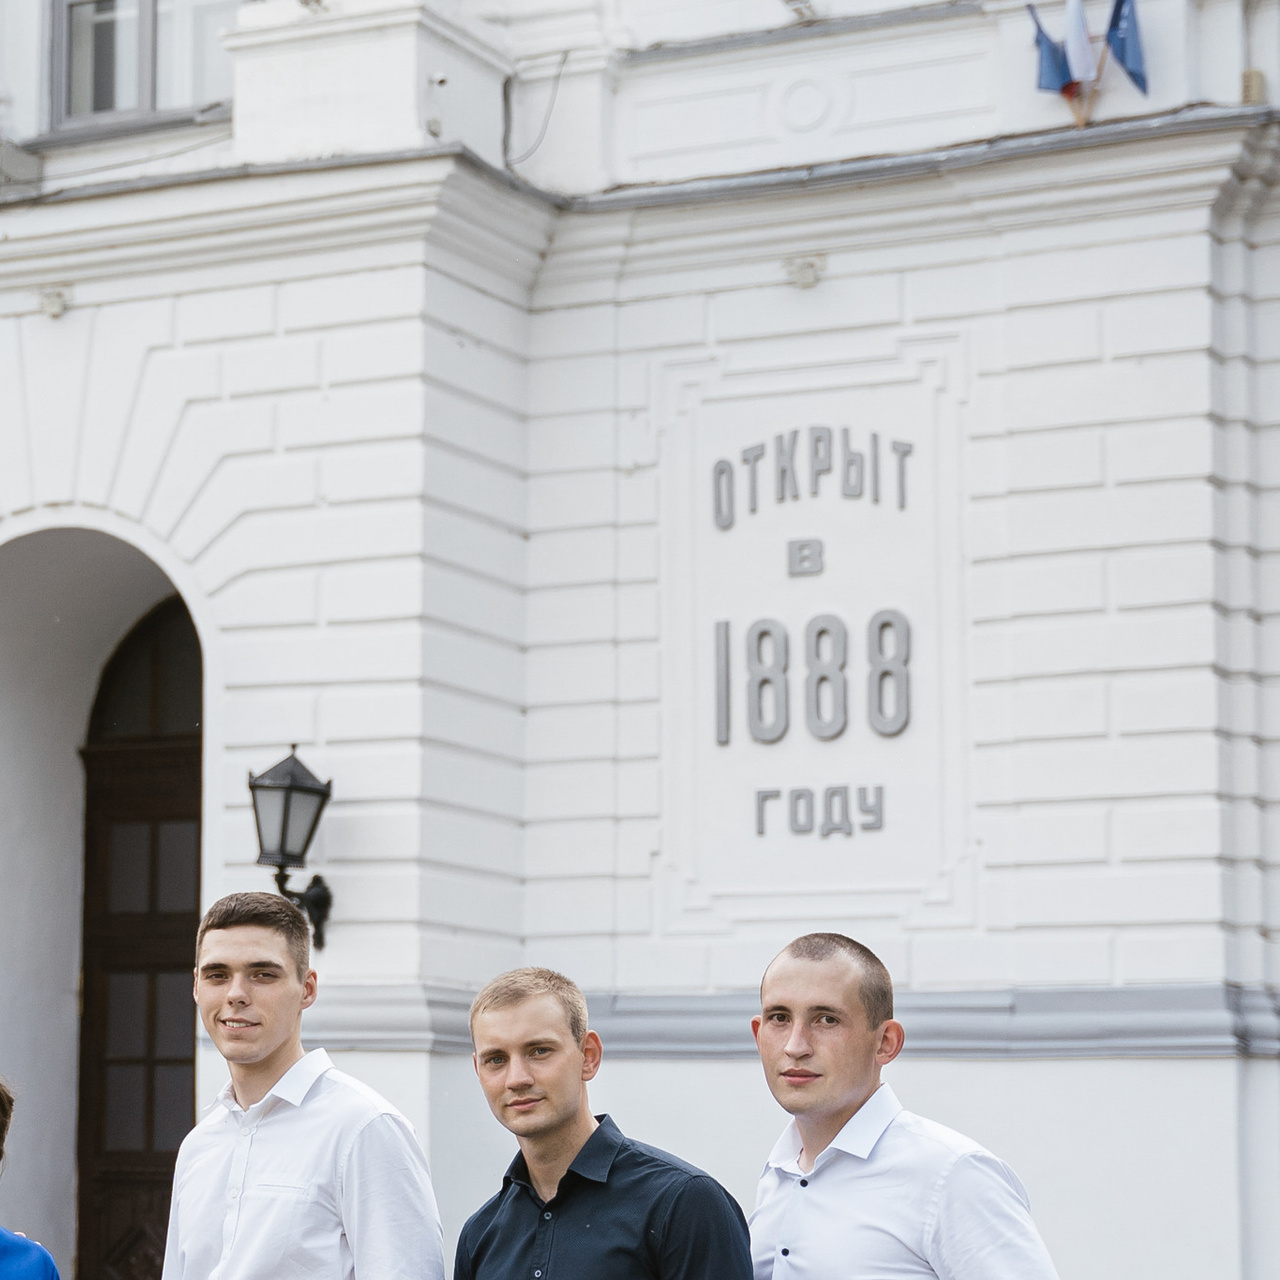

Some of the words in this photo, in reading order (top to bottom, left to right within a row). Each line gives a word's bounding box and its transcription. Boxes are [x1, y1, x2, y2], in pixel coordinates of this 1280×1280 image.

[714, 426, 913, 531] ОТКРЫТ
[787, 538, 824, 577] В
[715, 609, 911, 746] 1888
[756, 786, 885, 837] ГОДУ
